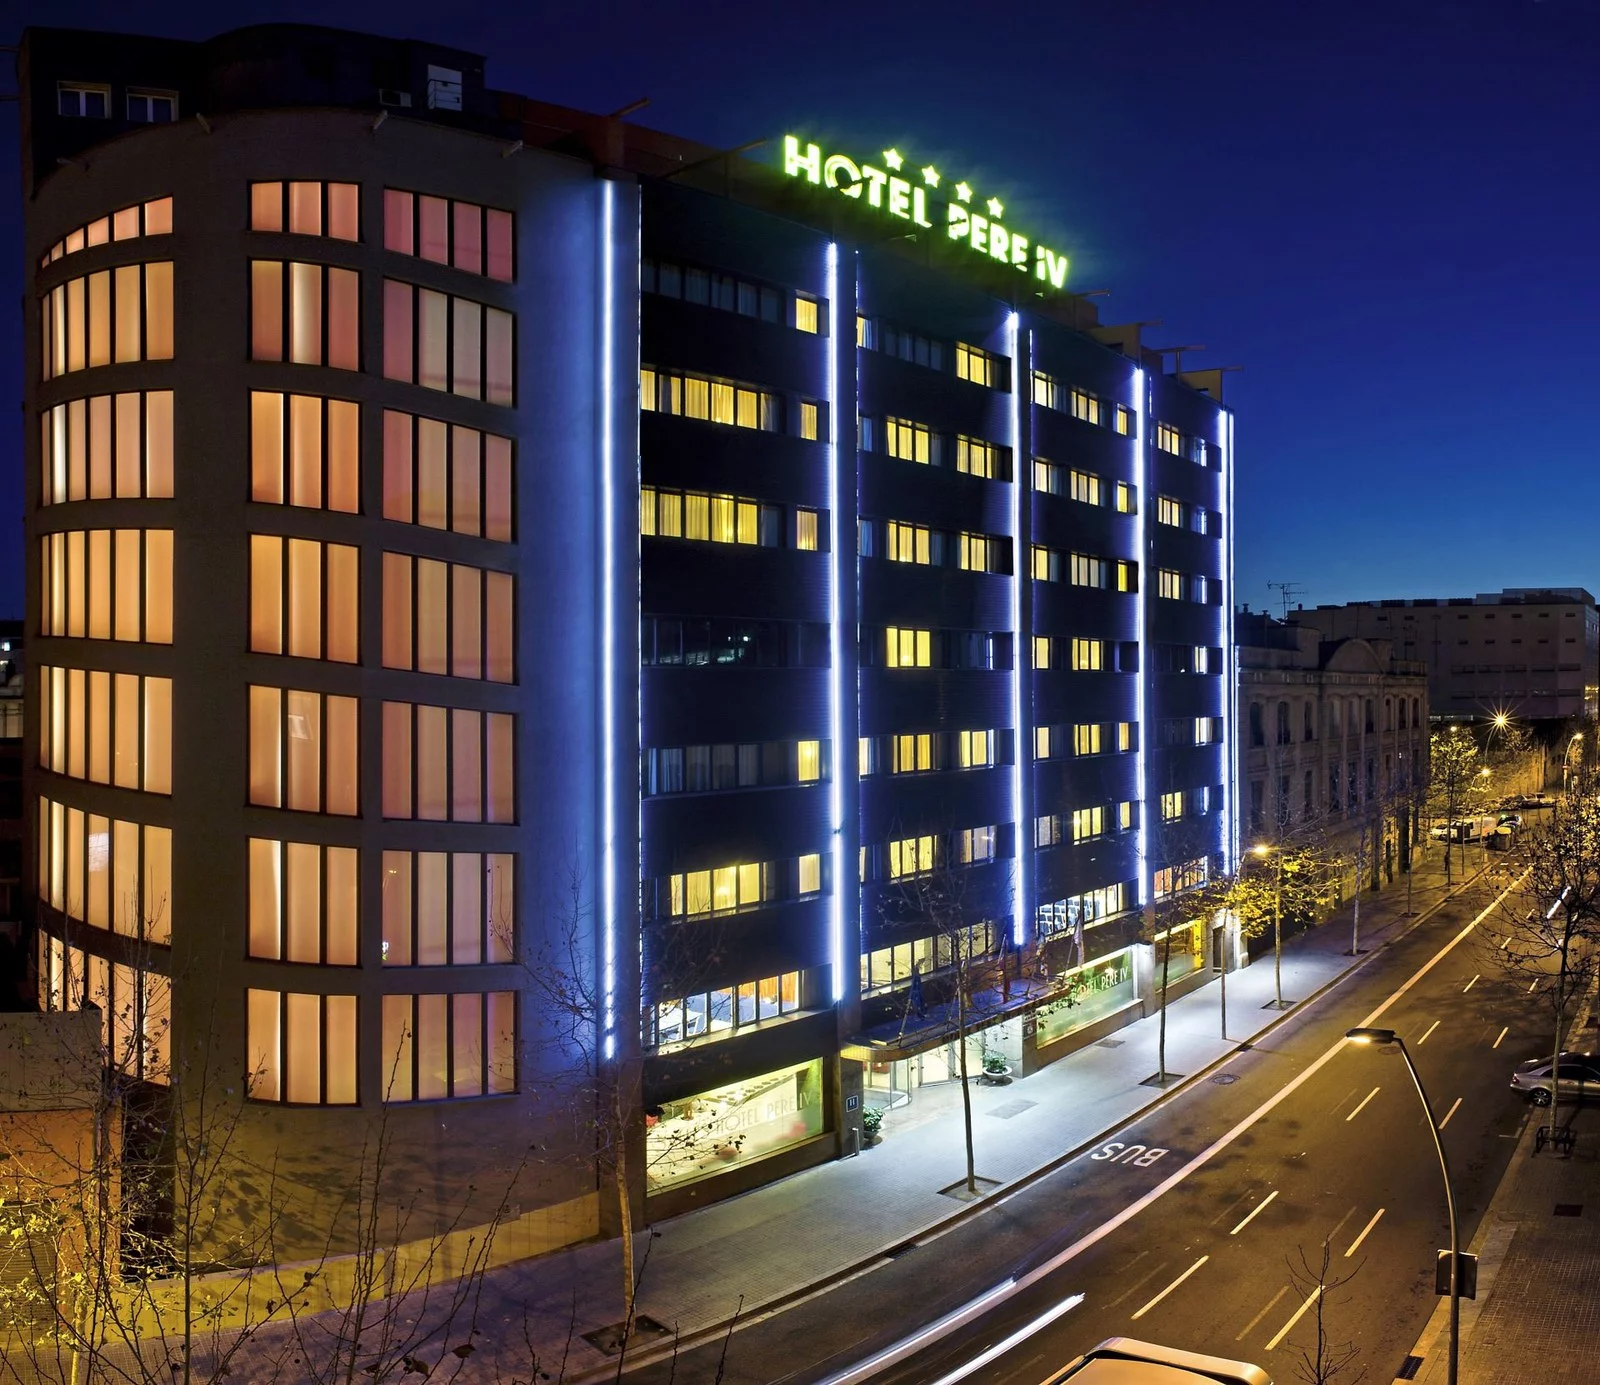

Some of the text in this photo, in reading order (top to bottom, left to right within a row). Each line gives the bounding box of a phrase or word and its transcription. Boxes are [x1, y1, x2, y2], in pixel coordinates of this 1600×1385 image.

[784, 134, 1068, 289] HOTEL PERE IV
[1101, 970, 1118, 991] PERE
[1120, 966, 1129, 983] IV
[766, 1097, 796, 1120] PERE
[799, 1091, 812, 1109] IV
[1090, 1142, 1170, 1168] BUS
